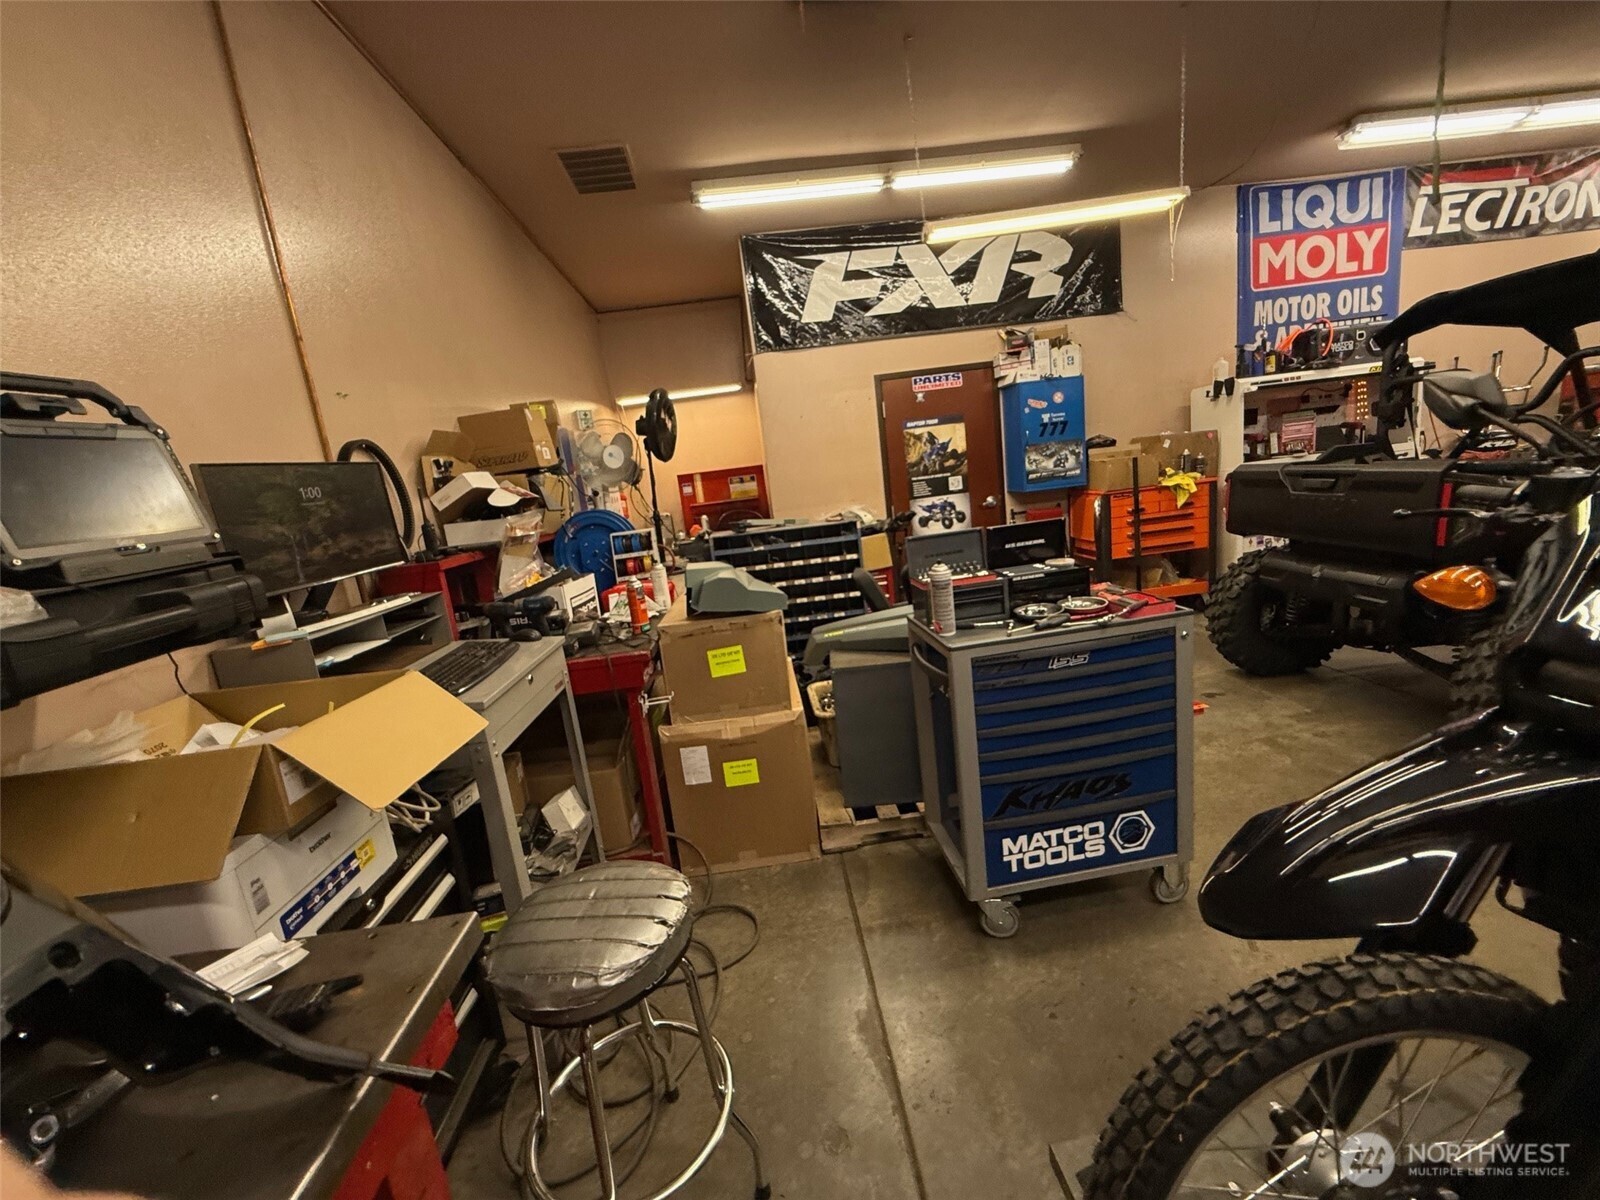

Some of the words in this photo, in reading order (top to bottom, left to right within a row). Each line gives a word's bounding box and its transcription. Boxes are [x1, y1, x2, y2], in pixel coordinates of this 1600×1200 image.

[1258, 177, 1385, 234] LIQUI
[1258, 228, 1387, 284] MOLY
[793, 231, 1074, 323] FXR
[1253, 293, 1330, 327] MOTOR
[1337, 284, 1383, 314] OILS
[913, 372, 961, 386] PARTS
[1039, 421, 1069, 437] 777
[299, 487, 322, 500] 1:00
[1002, 820, 1106, 856] MATCO
[1003, 838, 1106, 873] TOOLS
